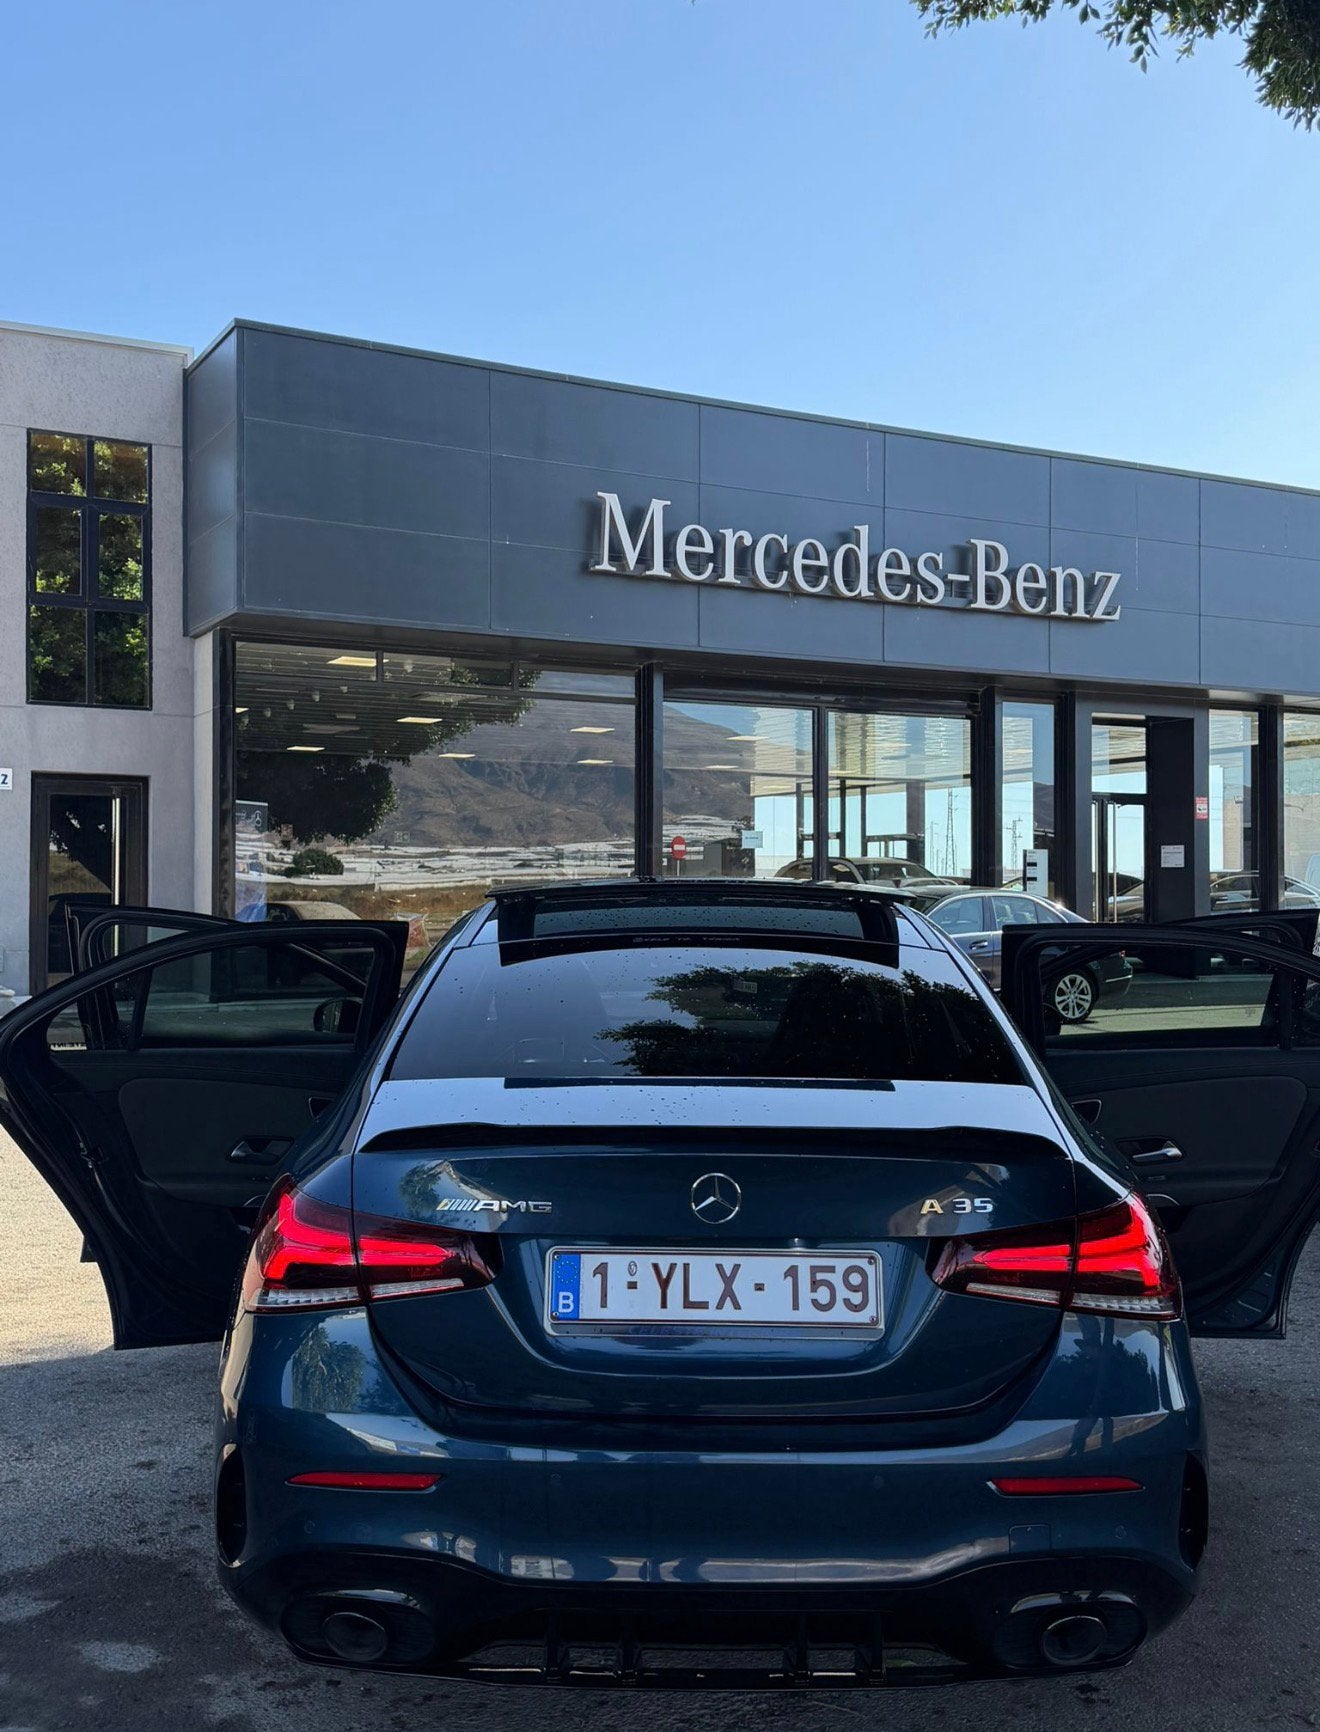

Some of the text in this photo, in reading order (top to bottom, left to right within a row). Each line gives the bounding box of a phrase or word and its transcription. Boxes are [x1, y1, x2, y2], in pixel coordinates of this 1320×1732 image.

[594, 491, 1122, 622] Mercedes-Benz
[473, 1199, 552, 1213] AMG
[920, 1198, 993, 1214] A 35
[558, 1291, 574, 1313] B
